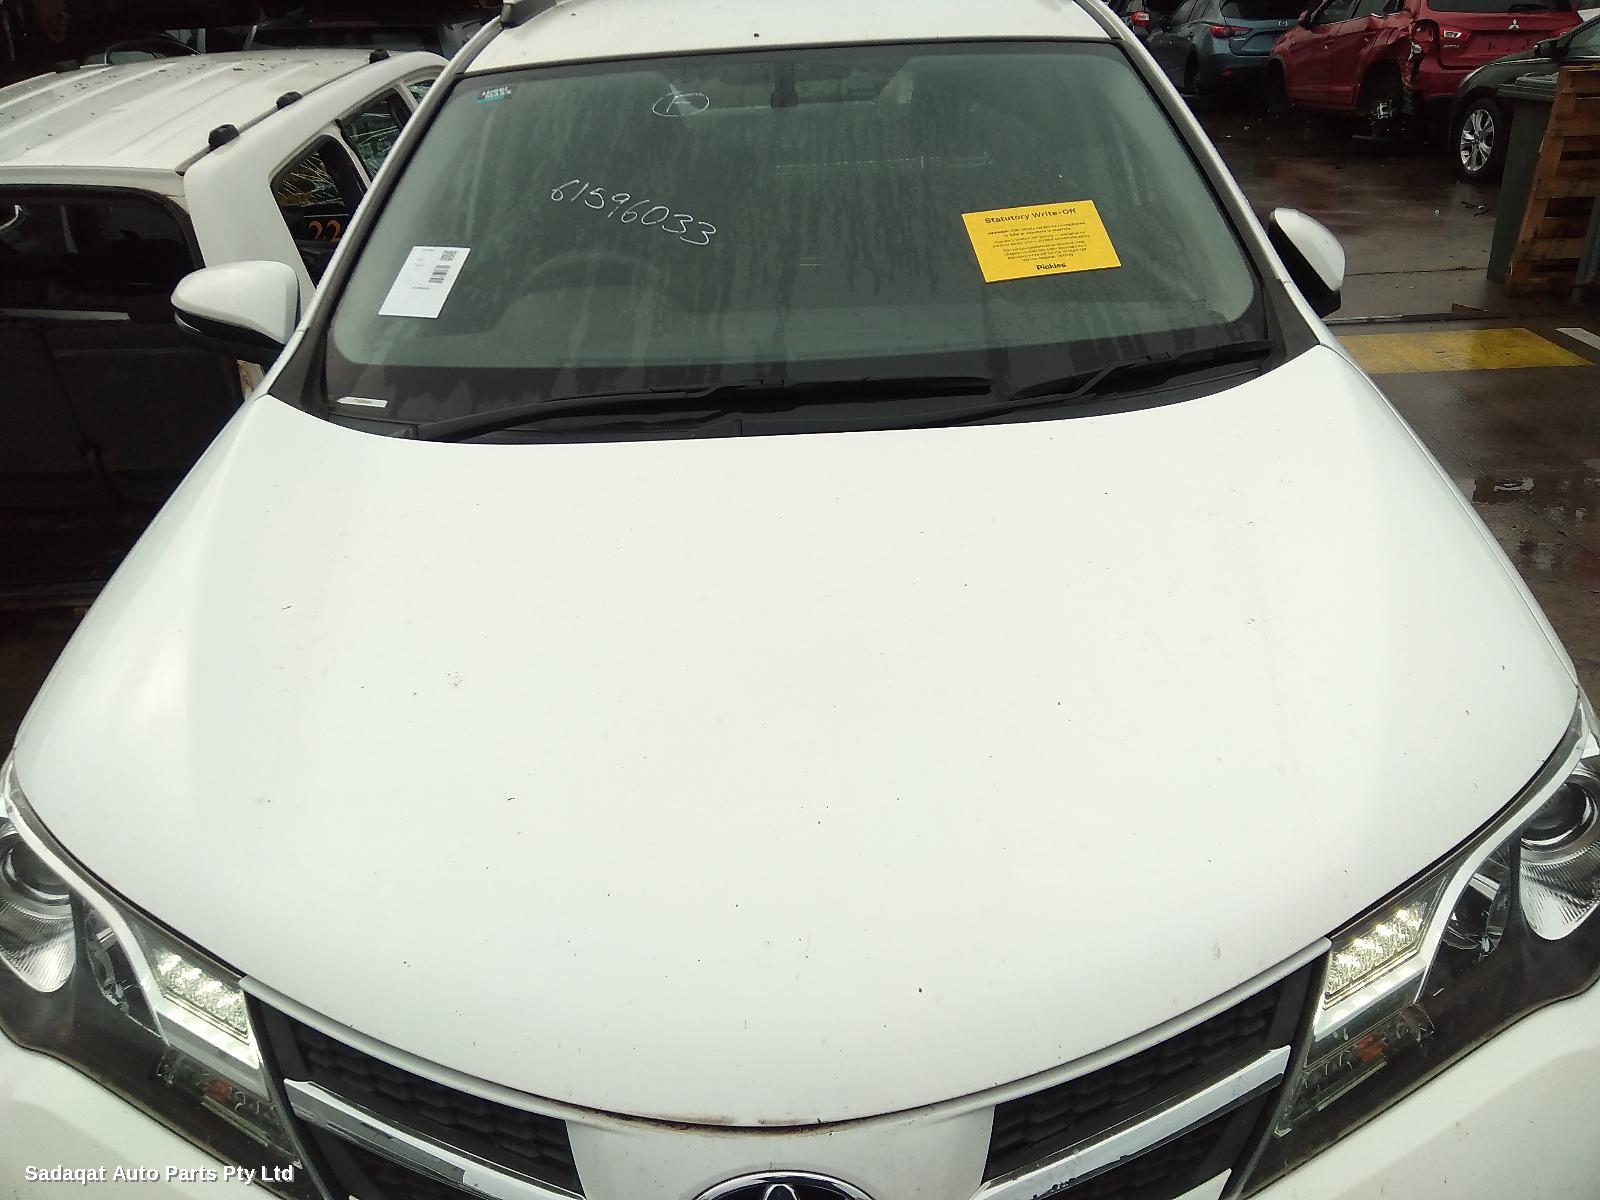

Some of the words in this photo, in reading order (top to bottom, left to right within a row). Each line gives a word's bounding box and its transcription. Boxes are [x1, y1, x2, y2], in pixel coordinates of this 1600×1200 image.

[551, 179, 717, 246] 61596033
[984, 213, 1030, 224] Statutory
[1031, 207, 1077, 219] Write-Off
[1036, 262, 1067, 271] Pickles
